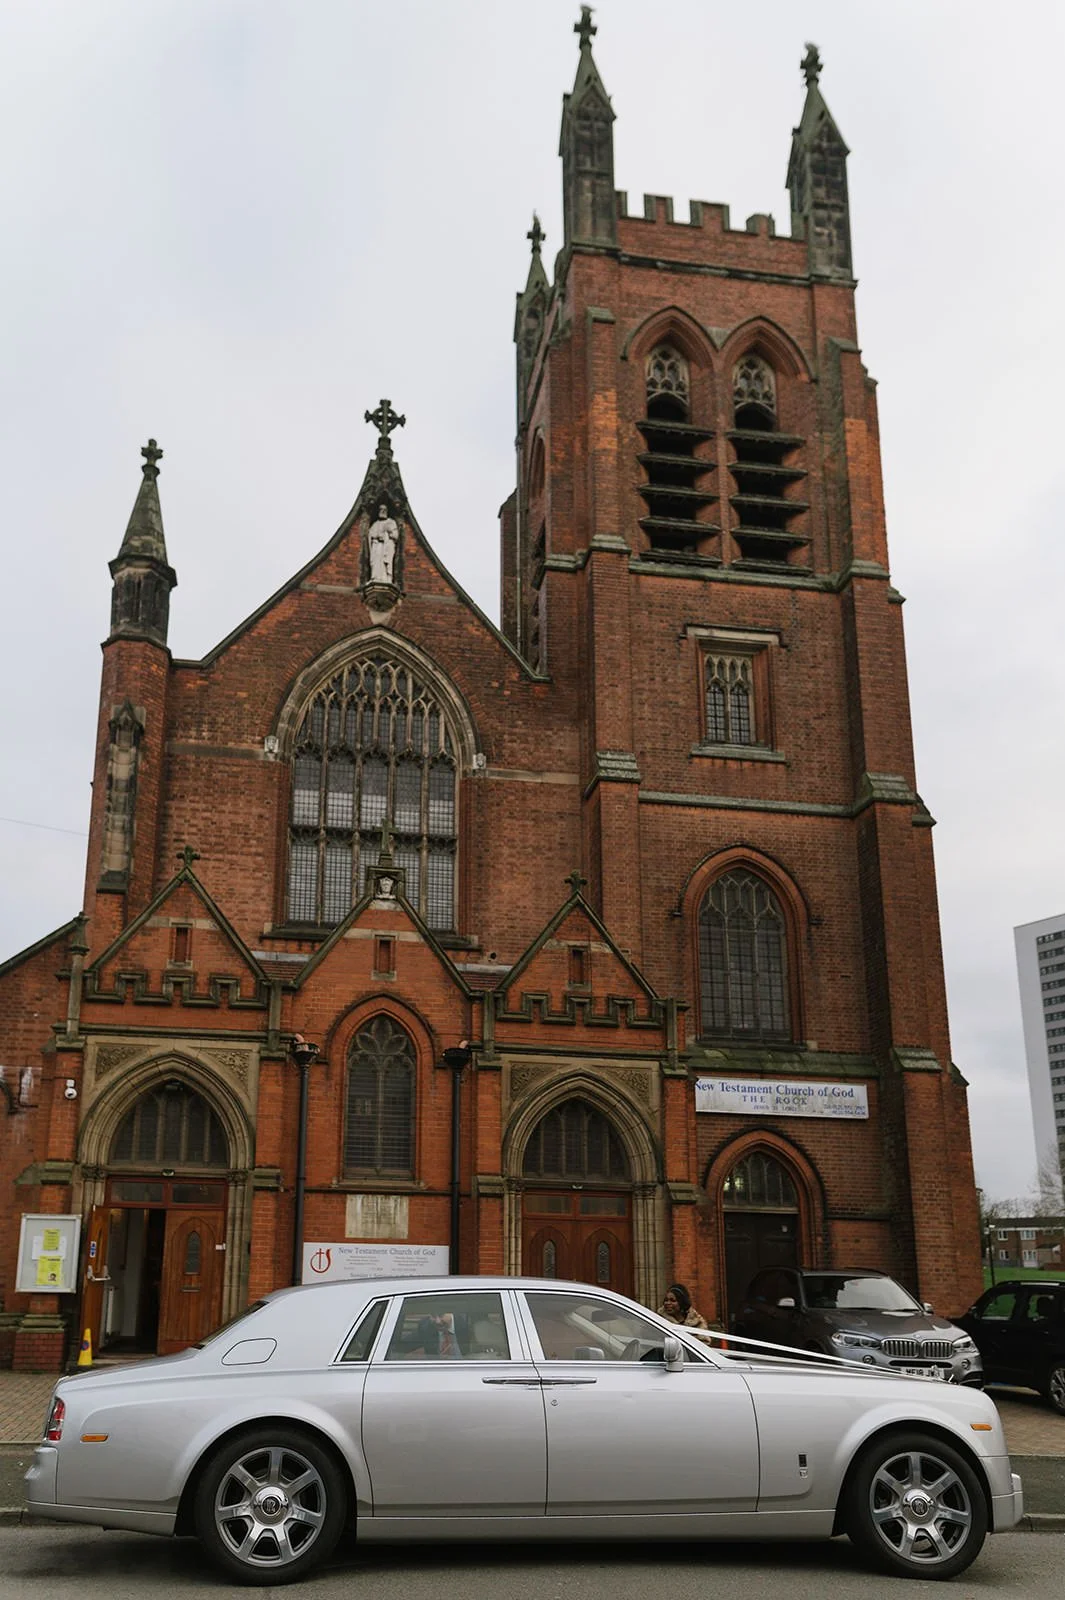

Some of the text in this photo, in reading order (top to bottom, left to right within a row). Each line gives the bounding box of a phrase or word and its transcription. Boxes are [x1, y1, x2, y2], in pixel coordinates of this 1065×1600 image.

[695, 1081, 854, 1098] New Testament Church of God
[743, 1095, 808, 1105] THE ROCK
[354, 1247, 388, 1255] Testament
[389, 1248, 412, 1256] Church
[414, 1248, 421, 1256] of
